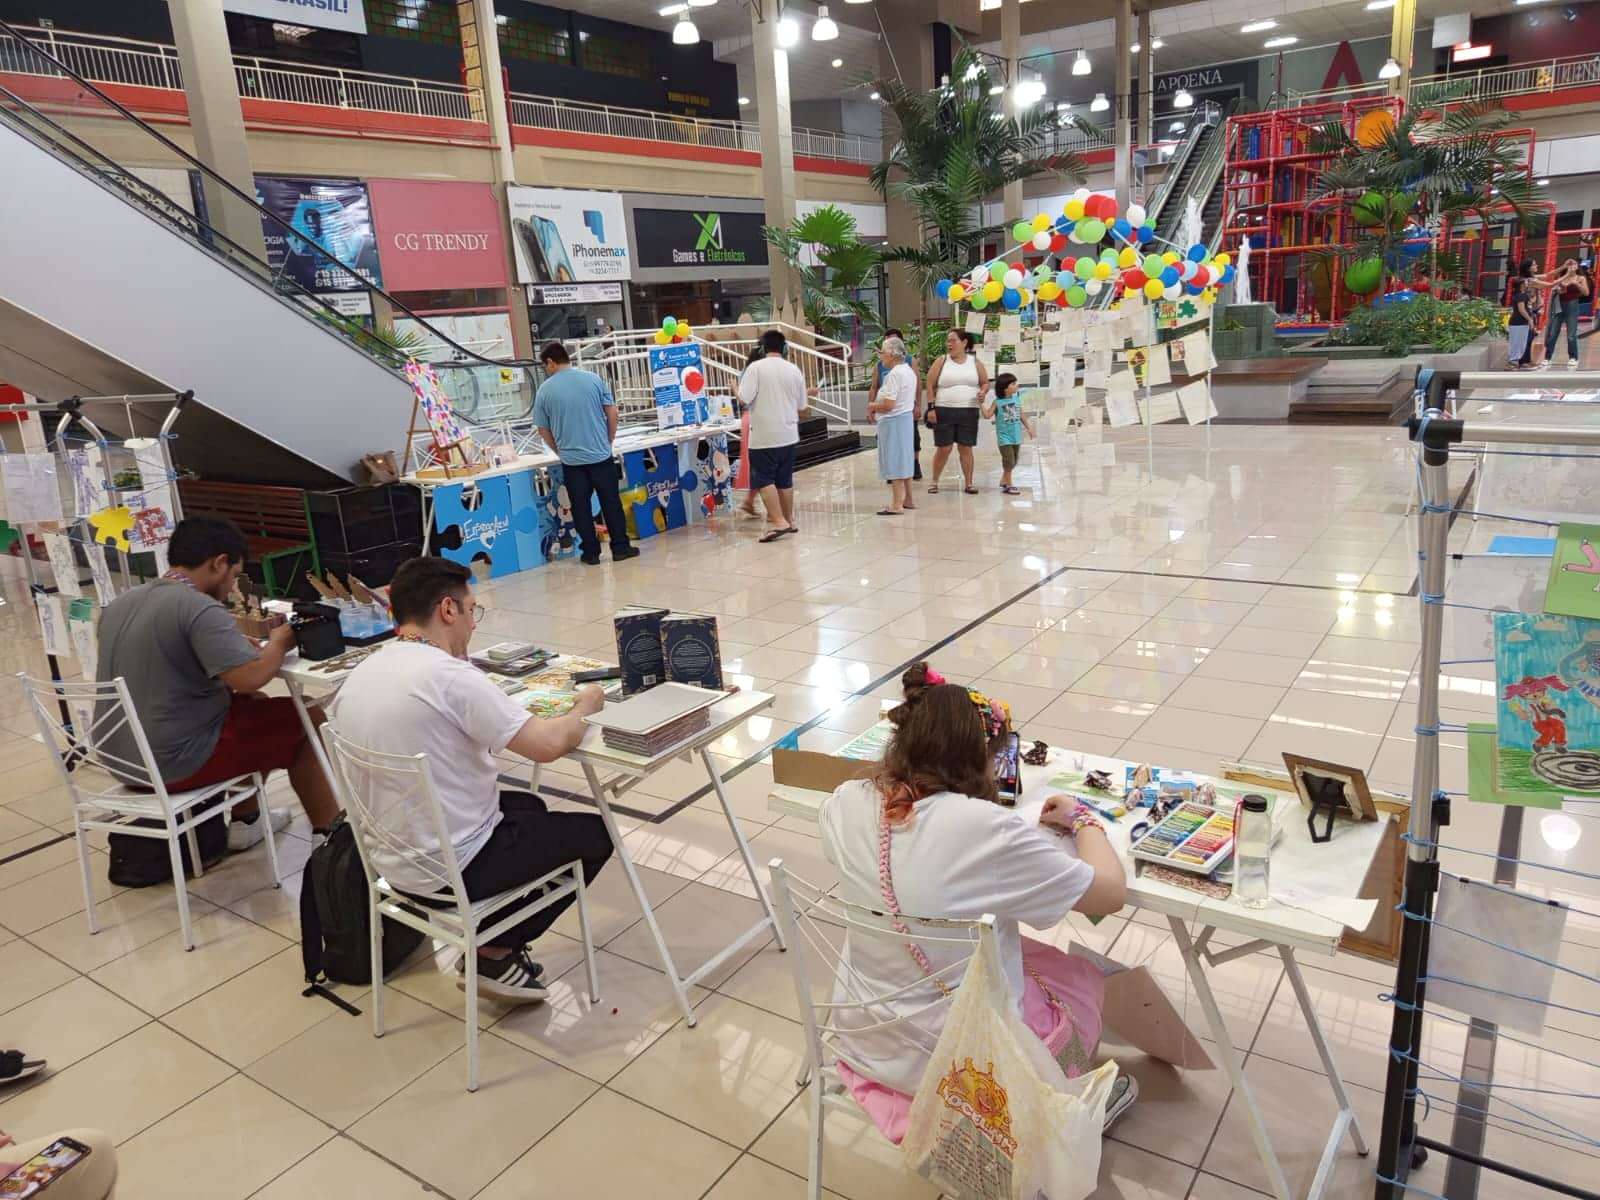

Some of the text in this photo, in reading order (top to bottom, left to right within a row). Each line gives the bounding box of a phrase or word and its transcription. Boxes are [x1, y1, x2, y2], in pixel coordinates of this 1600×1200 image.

[278, 0, 348, 13] ASIL!
[1157, 69, 1223, 90] APOENA
[394, 233, 489, 251] CG TRENDY
[572, 243, 626, 258] iPhonemax
[672, 249, 698, 263] Games
